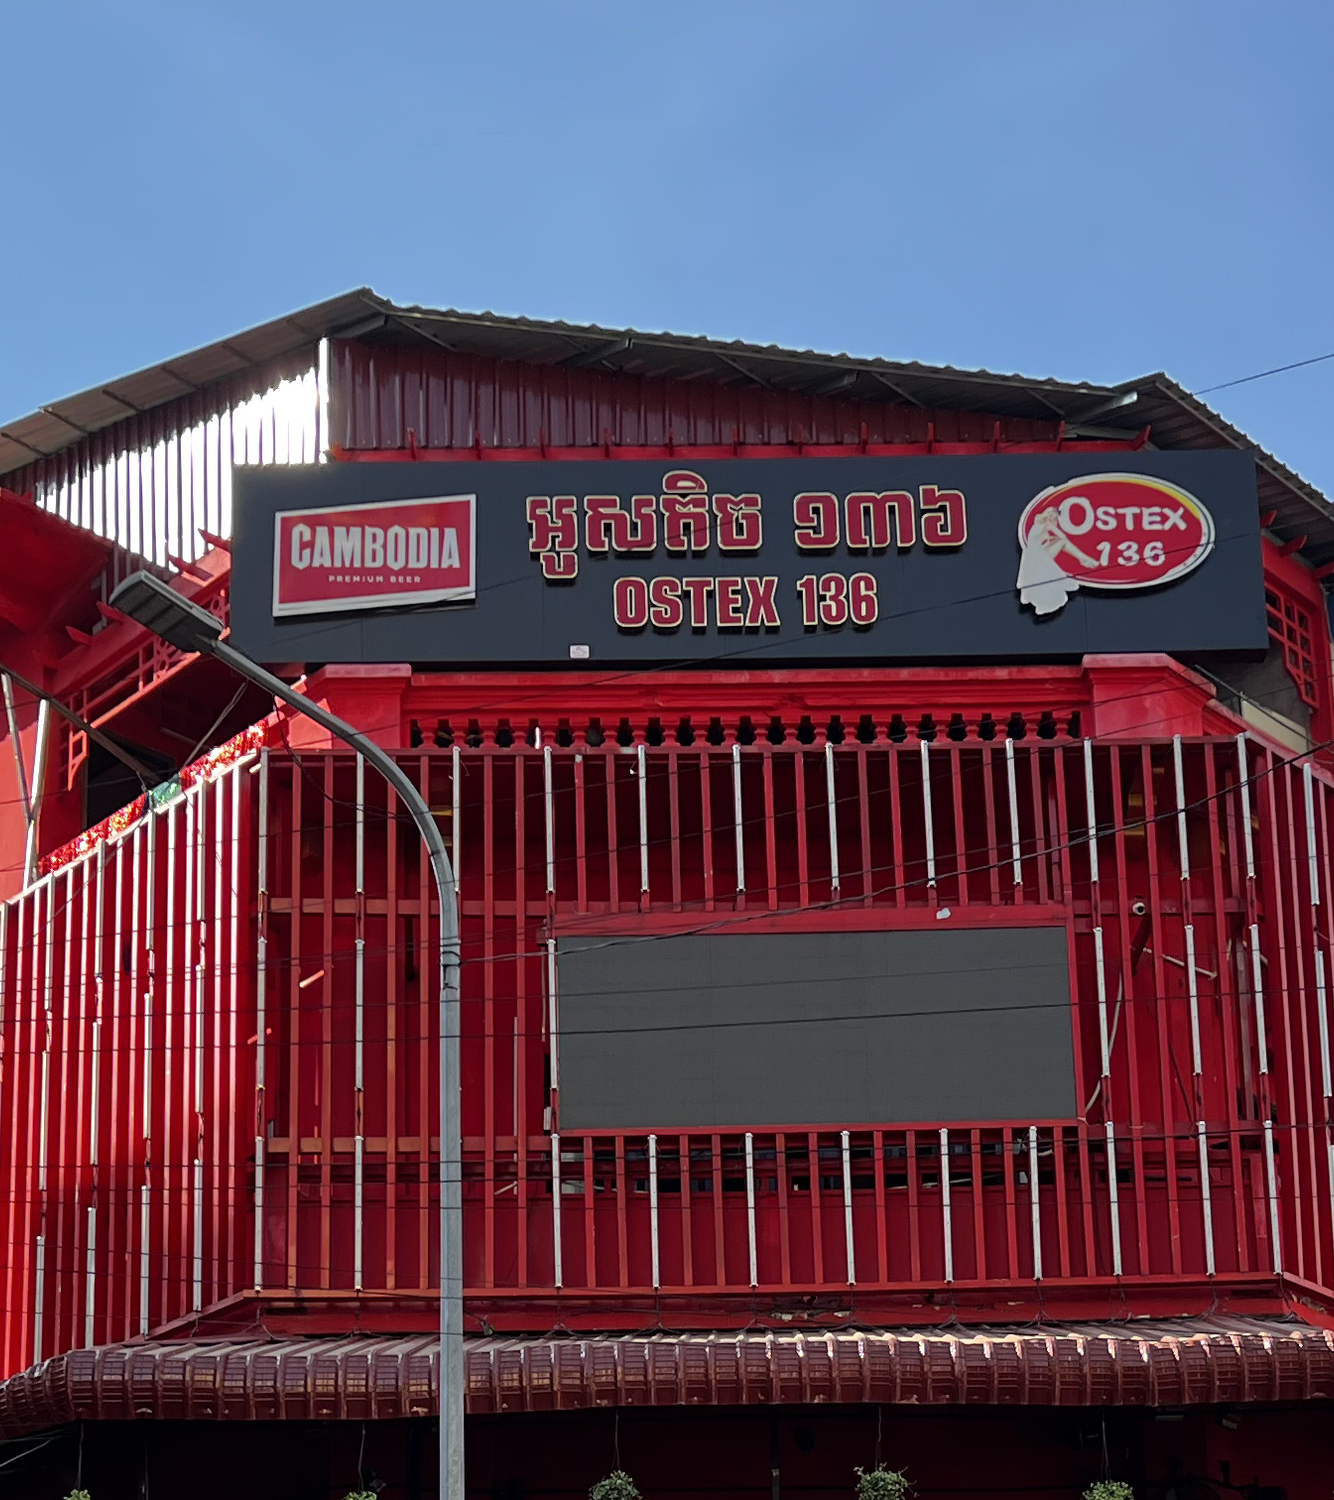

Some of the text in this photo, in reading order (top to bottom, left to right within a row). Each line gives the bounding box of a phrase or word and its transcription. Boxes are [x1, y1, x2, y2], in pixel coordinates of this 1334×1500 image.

[794, 485, 967, 549] ១៣៦
[1058, 496, 1187, 536] OSTEX
[291, 523, 460, 570] CAMBODIA
[1097, 541, 1165, 566] 136
[328, 575, 421, 583] PREMIUM BEER
[613, 572, 878, 627] OSTEX 136
